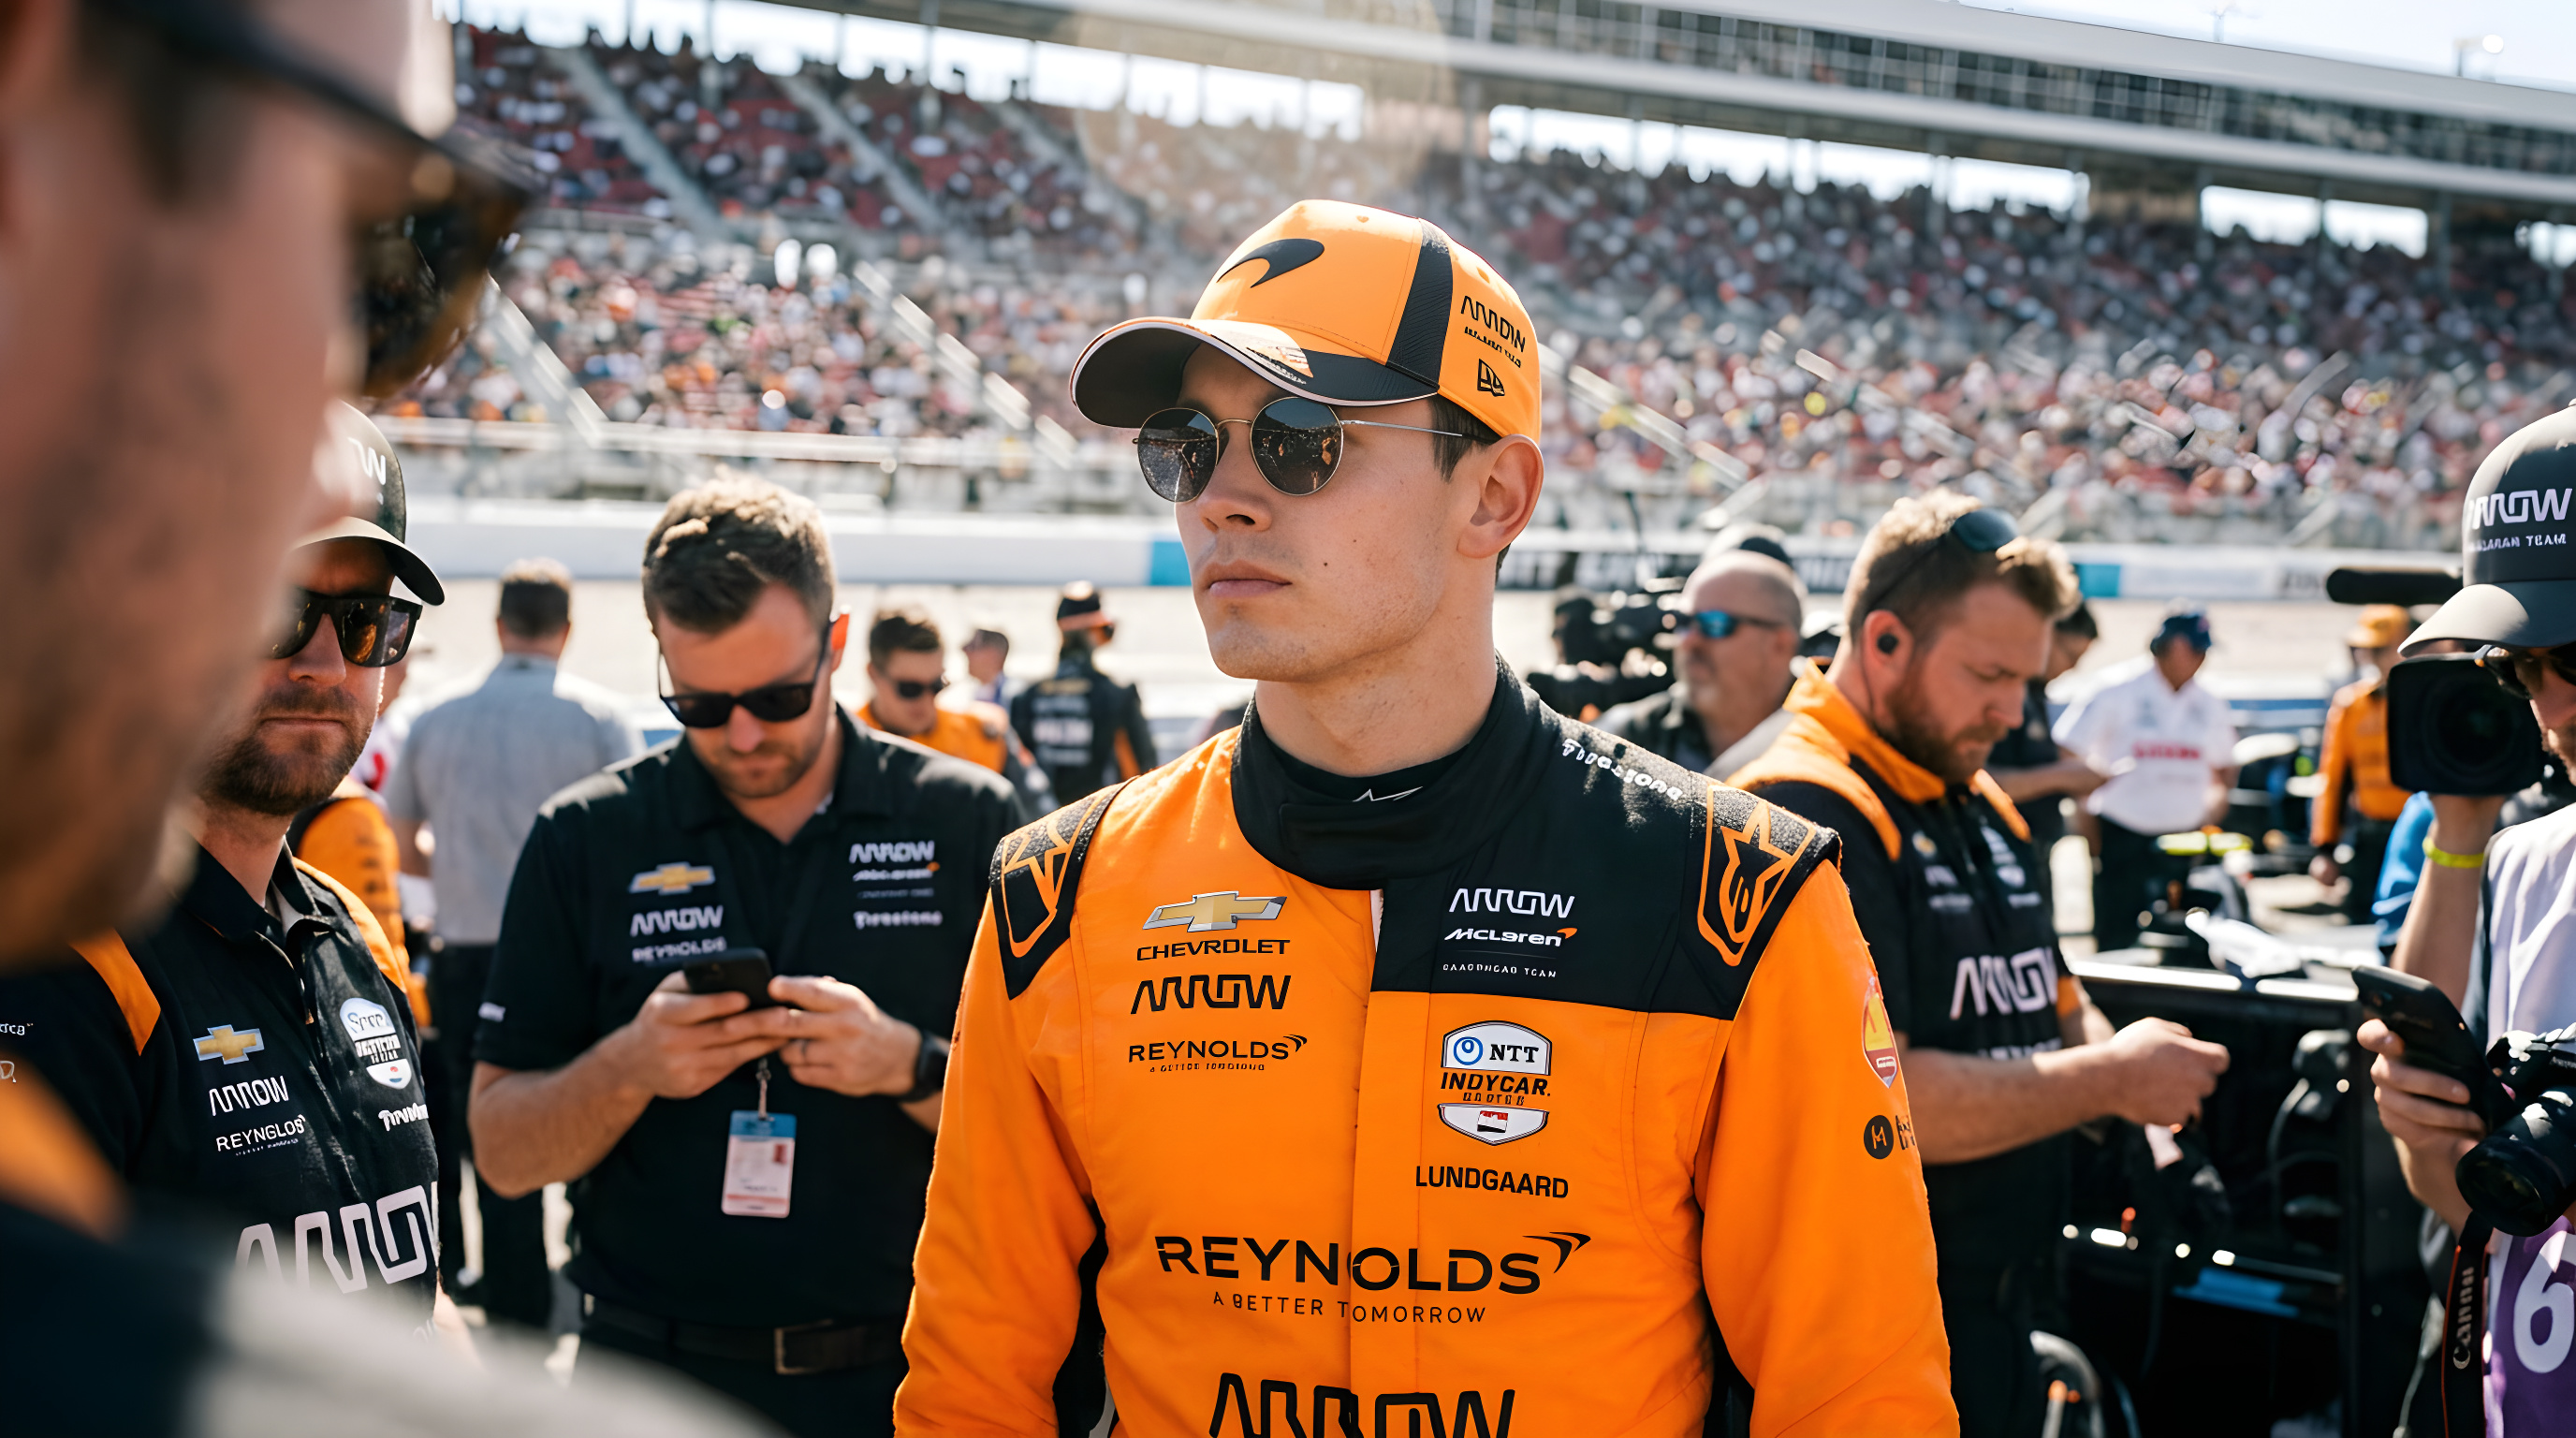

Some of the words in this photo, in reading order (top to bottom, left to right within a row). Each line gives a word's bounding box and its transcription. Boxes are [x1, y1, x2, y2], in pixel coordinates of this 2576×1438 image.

[1136, 939, 1291, 961] CHEVROLET
[1129, 1040, 1289, 1063] REYNOLDS
[1489, 1043, 1540, 1064] NTT
[1415, 1166, 1569, 1199] LUNDGAARD
[1154, 1236, 1542, 1295] REYNOLDS
[1213, 1291, 1224, 1306] A
[1337, 1301, 1486, 1324] TOMORROW
